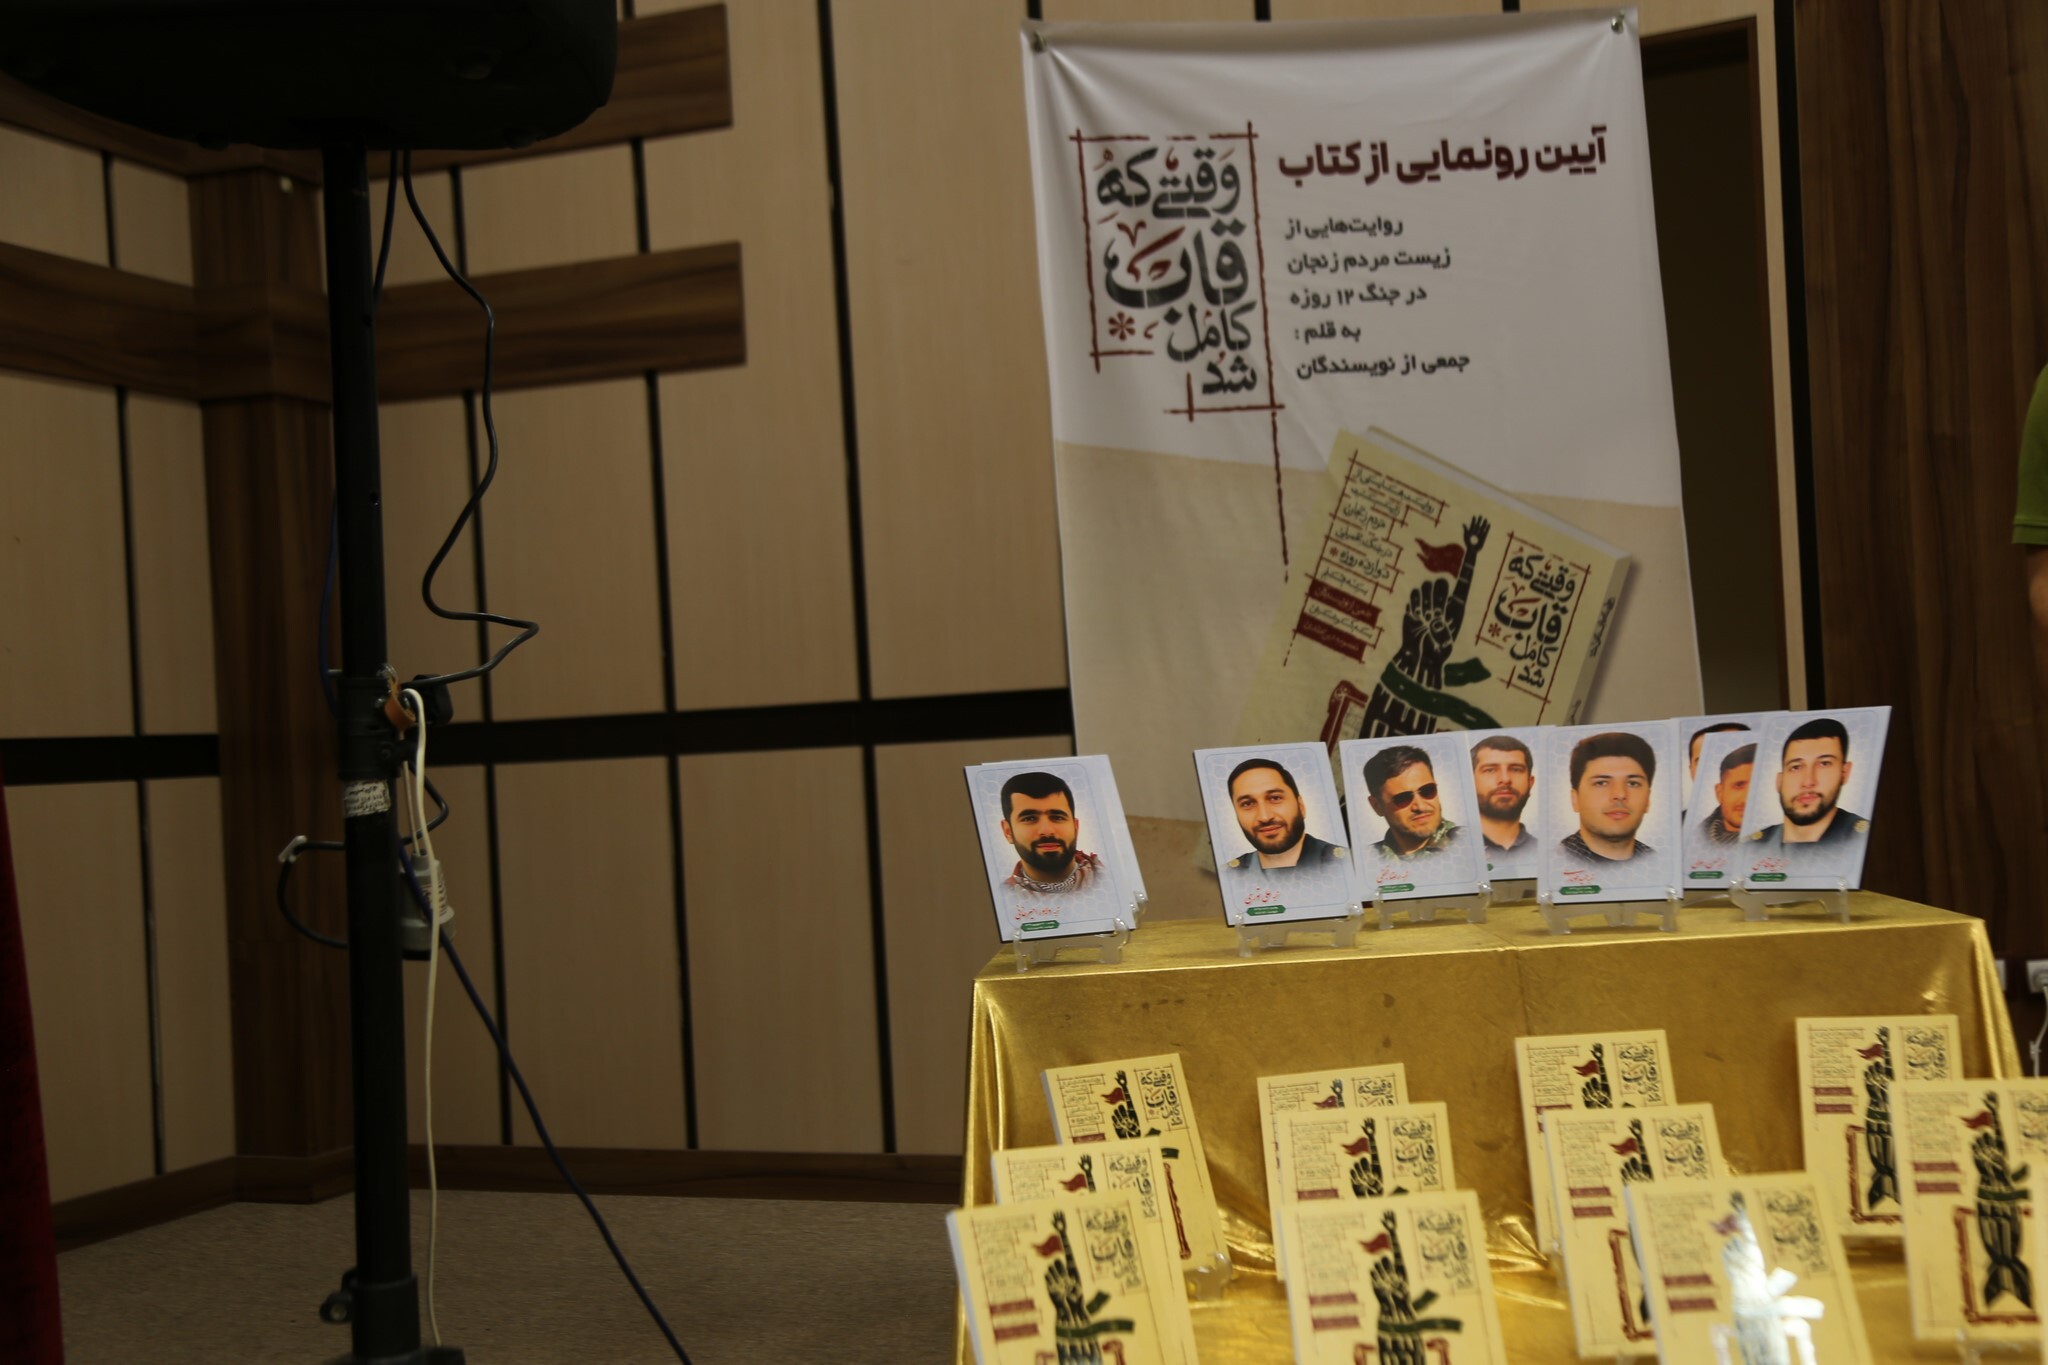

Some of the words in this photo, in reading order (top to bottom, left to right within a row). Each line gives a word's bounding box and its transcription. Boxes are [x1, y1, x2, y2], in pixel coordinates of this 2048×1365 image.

[1396, 138, 1530, 184] رونمایی
[1534, 124, 1607, 175] آیین
[1278, 139, 1361, 188] کتاب
[1364, 141, 1389, 186] از
[1285, 217, 1301, 240] از
[1103, 218, 1250, 318] قاب
[1287, 251, 1340, 275] زنجان
[1343, 252, 1390, 273] مردم
[1394, 246, 1451, 270] زیست
[1289, 288, 1331, 309] روزه
[1358, 283, 1401, 306] جنگ
[1405, 286, 1428, 305] در
[1166, 301, 1258, 363] کامل
[1303, 320, 1337, 345] قلم
[1340, 325, 1362, 343] به
[1202, 355, 1258, 395] شد
[1296, 354, 1396, 379] نویسندگان
[1400, 354, 1417, 375] از
[1420, 354, 1471, 374] جمعی
[1516, 664, 1546, 689] شد
